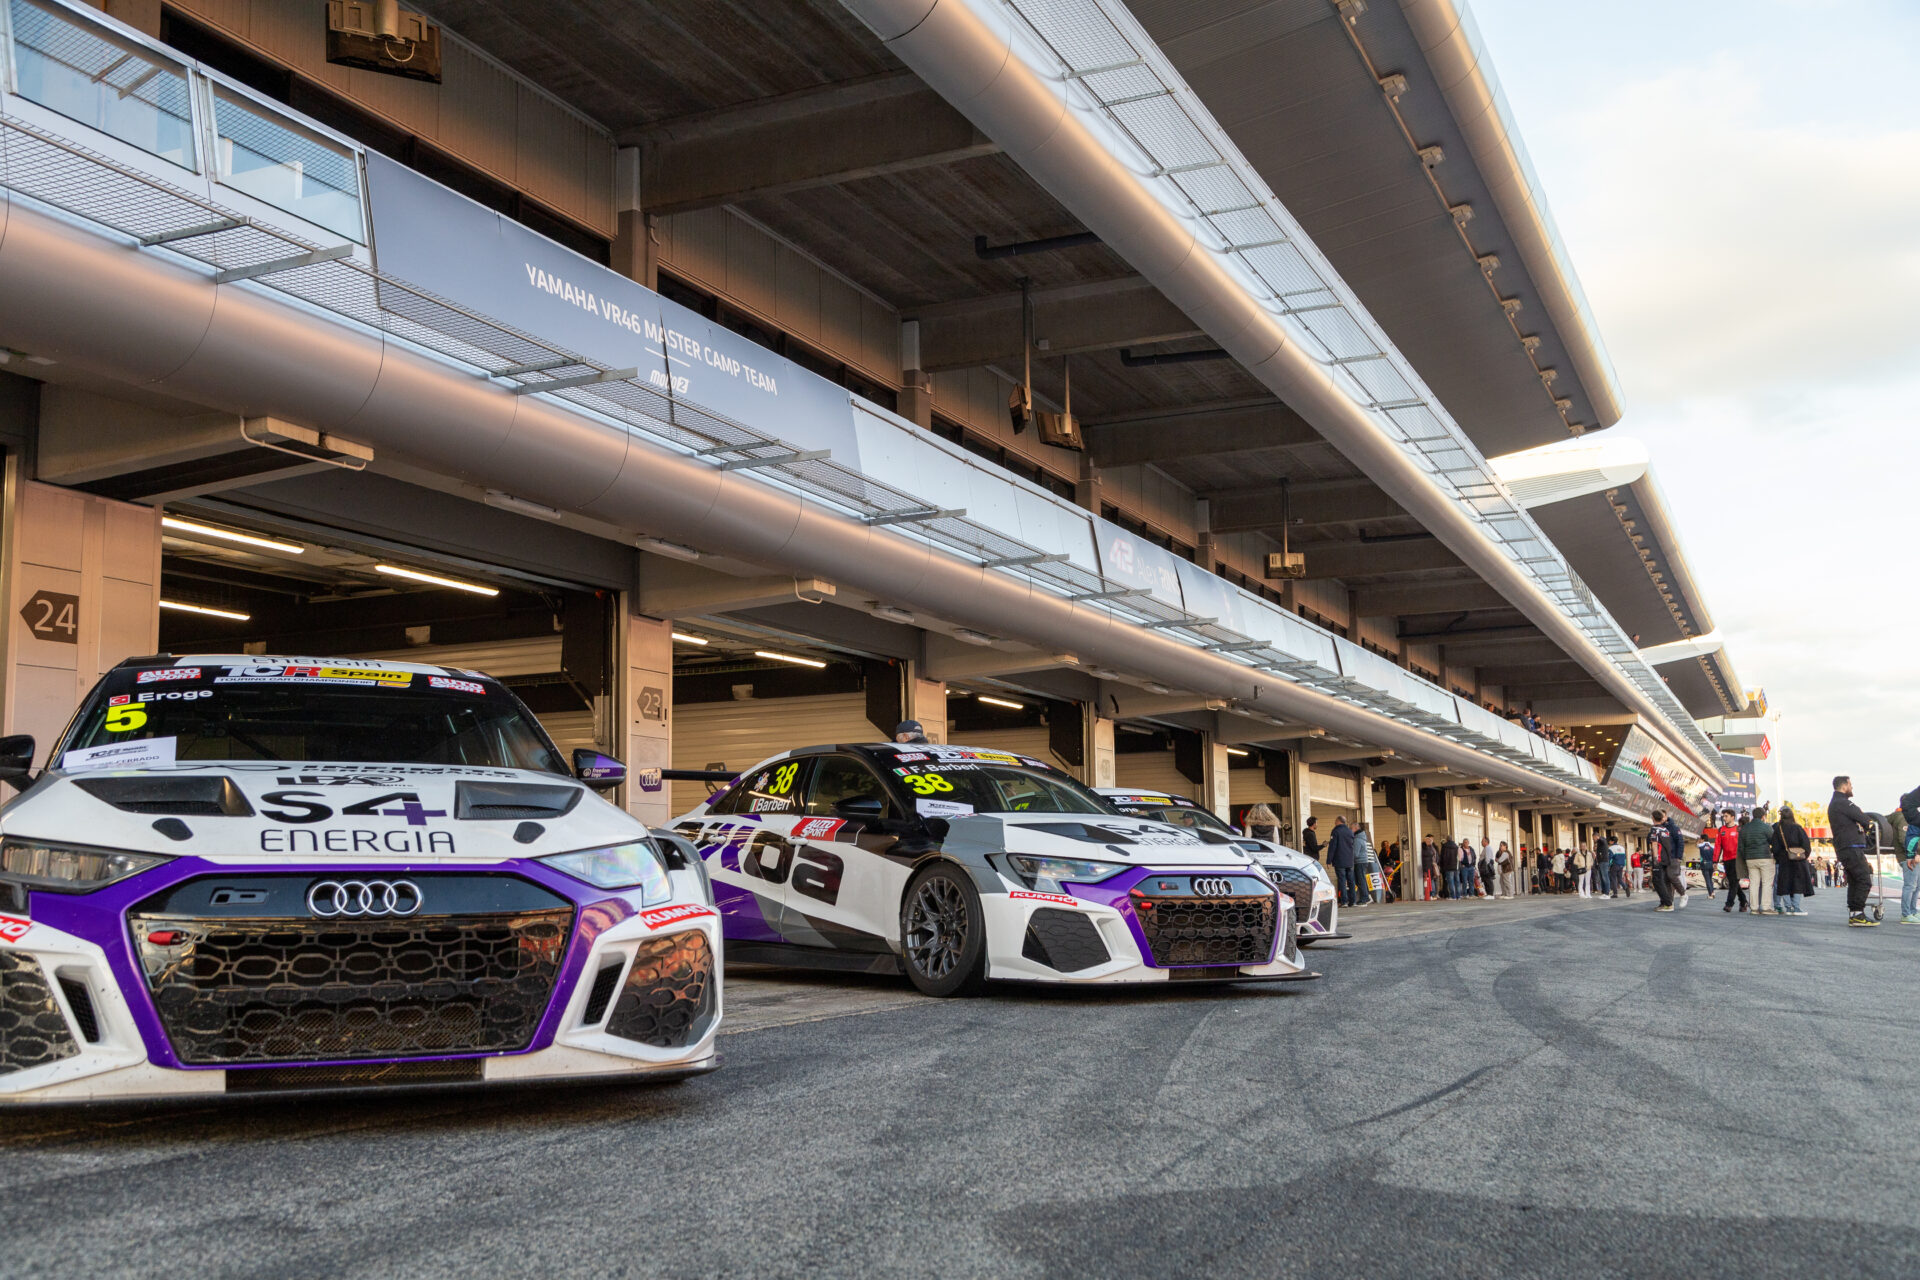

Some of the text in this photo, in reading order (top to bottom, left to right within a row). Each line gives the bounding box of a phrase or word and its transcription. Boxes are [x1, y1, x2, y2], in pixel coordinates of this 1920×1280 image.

[525, 263, 778, 396] YAMAHA VR46 MASTER CAMP TEAM
[34, 599, 76, 635] 24
[137, 673, 196, 684] SPORT
[138, 668, 201, 678] AUTO
[221, 665, 402, 680] TCR Spain
[430, 676, 485, 690] AUTO
[430, 682, 483, 694] SPORT
[138, 689, 214, 703] Eroge
[643, 692, 661, 716] 23
[105, 702, 148, 733] 5
[930, 751, 978, 760] TCR
[909, 765, 925, 774] F.
[768, 762, 799, 795] 38
[903, 773, 954, 795] 38
[806, 820, 836, 829] AUTO
[800, 827, 829, 838] SPORT
[260, 829, 455, 854] ENERGIA
[1012, 892, 1075, 904] KUMHO
[644, 904, 707, 926] KUMHO
